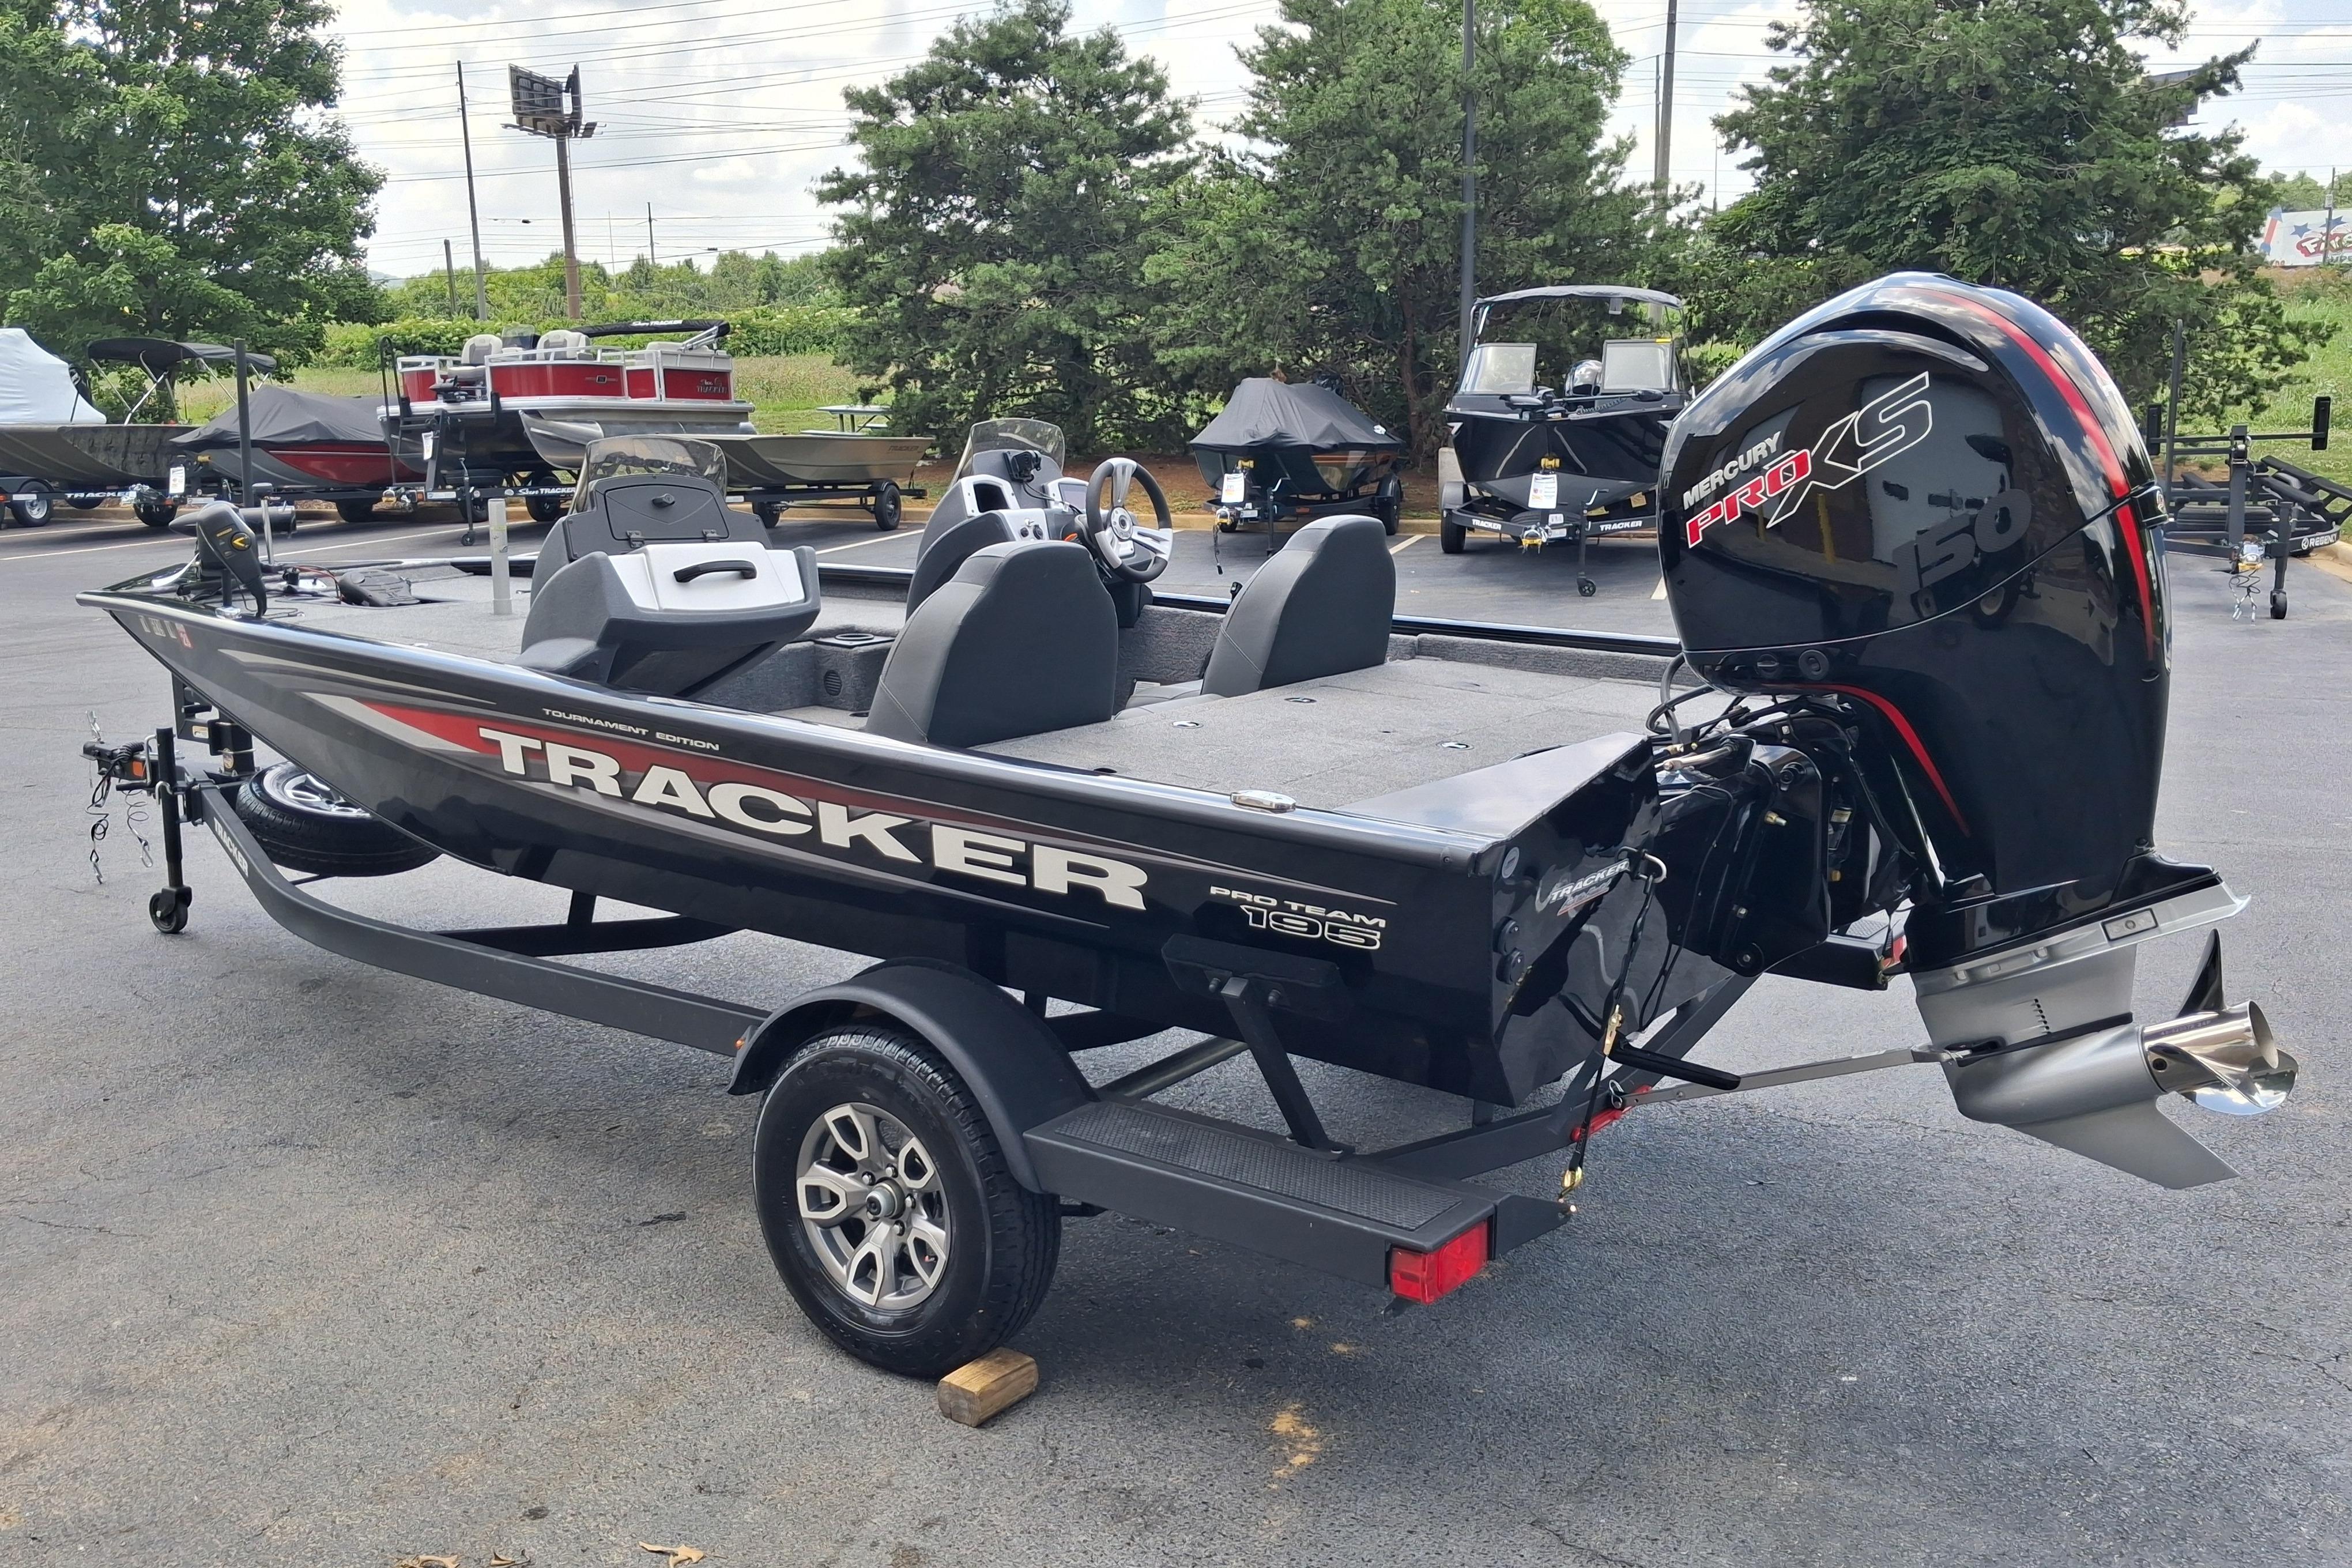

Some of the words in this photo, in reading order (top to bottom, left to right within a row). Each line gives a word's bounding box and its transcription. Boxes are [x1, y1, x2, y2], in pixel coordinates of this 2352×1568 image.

[1683, 430, 1782, 510] MERCURY
[1686, 448, 1812, 549] PRO
[1472, 518, 1502, 531] TRACKER
[1600, 520, 1643, 532] TRACKER
[1893, 488, 2031, 597] 150
[542, 708, 649, 736] TOURNAMENT
[655, 732, 720, 751] EDITION
[478, 727, 1148, 911] TRACKER
[213, 816, 249, 877] TRACKER
[1550, 860, 1630, 902] TRACKER
[1210, 885, 1277, 906] PRO
[1284, 900, 1386, 928] TEAM
[1239, 904, 1381, 950] 195
